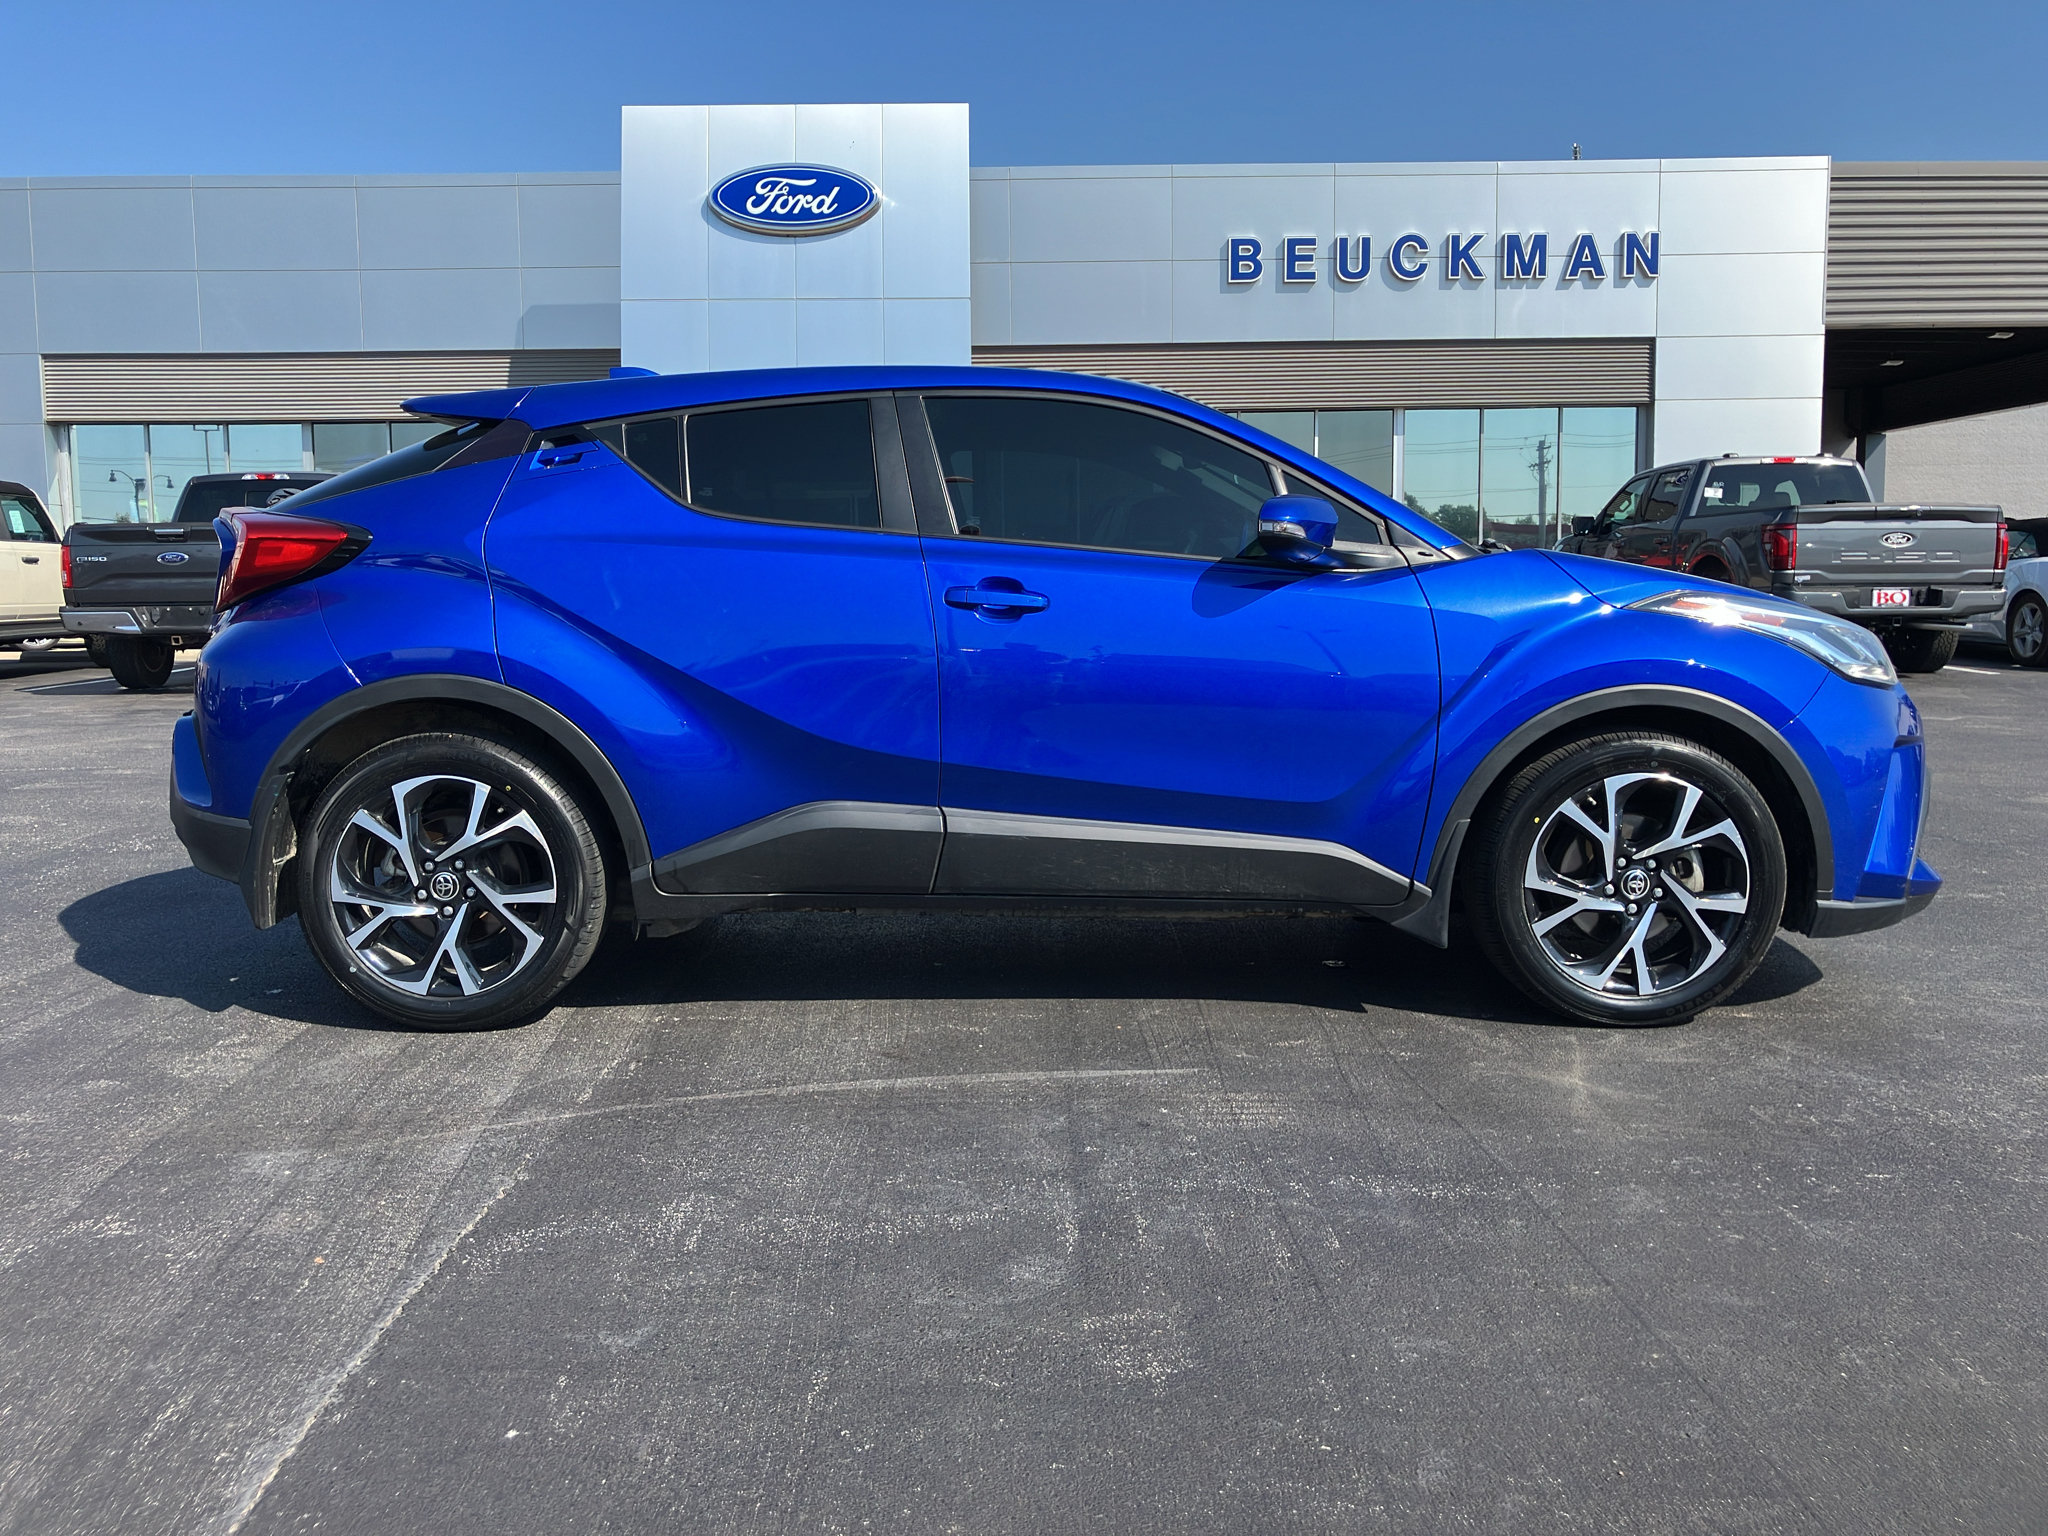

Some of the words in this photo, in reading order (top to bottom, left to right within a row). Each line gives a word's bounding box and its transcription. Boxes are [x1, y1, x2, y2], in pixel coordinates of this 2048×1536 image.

[746, 176, 841, 215] Ford
[1227, 230, 1661, 284] BEUCKMAN
[1876, 591, 1907, 605] BO
[1664, 983, 1724, 1017] ROVELO
